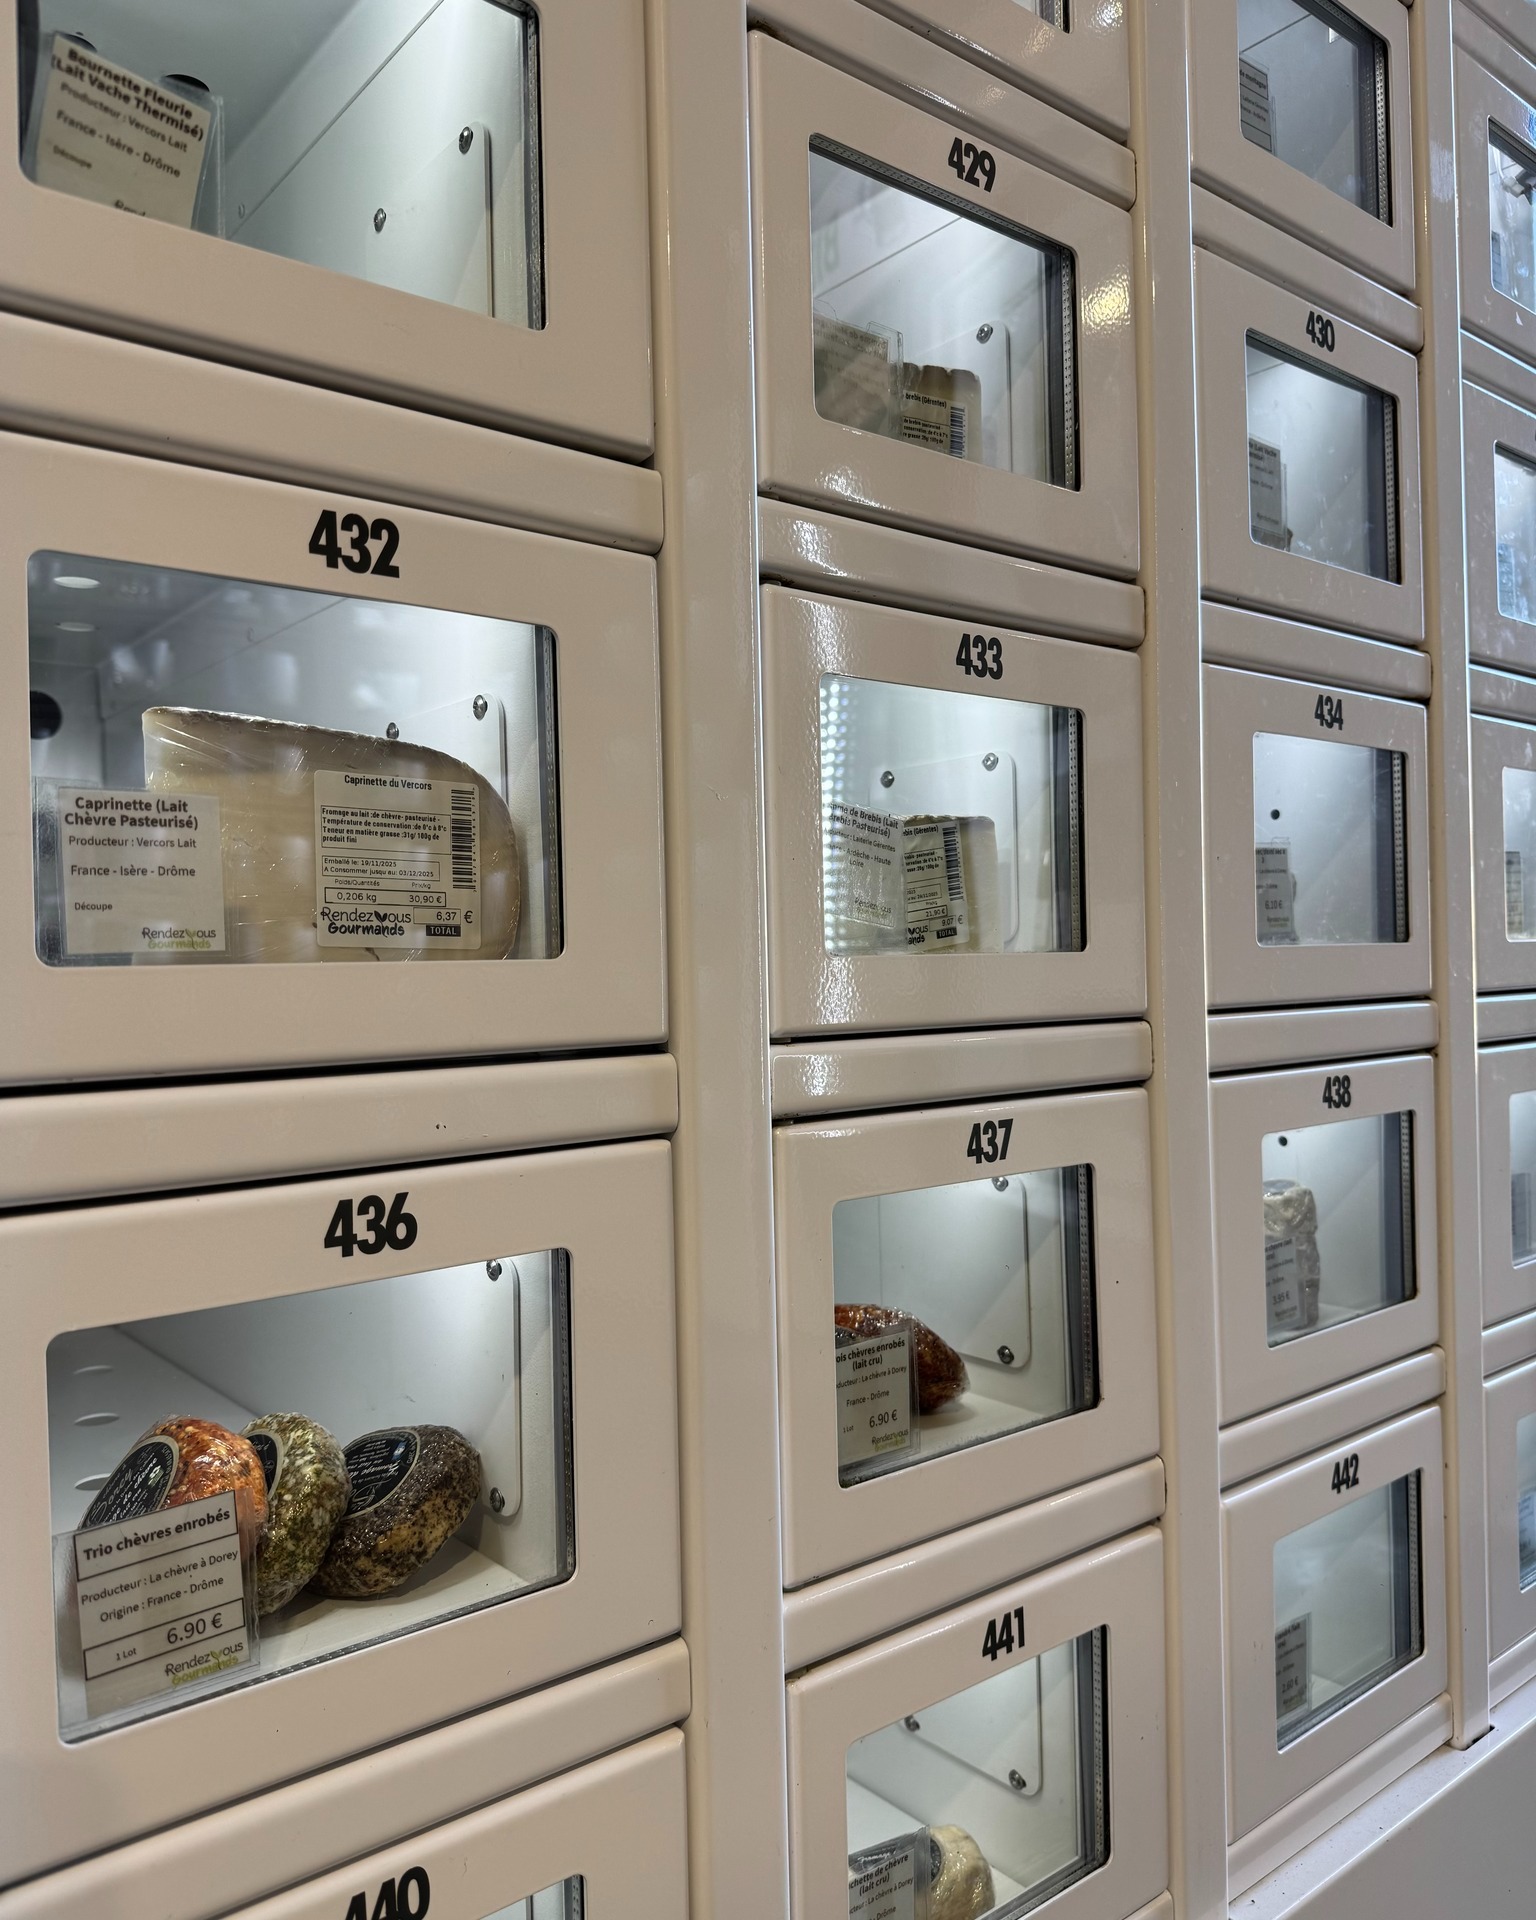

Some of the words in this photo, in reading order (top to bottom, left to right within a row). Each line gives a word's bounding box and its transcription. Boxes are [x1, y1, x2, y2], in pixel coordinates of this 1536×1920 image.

[68, 48, 141, 94] Bournette
[144, 87, 193, 119] Fleurie
[51, 54, 84, 82] (Lait
[88, 72, 130, 104] Vache
[134, 97, 204, 141] Thermisé)
[60, 82, 120, 119] Producteur
[129, 118, 166, 143] Vercors
[168, 136, 188, 153] Lait
[57, 109, 97, 138] France
[105, 134, 134, 156] Isère
[143, 151, 181, 178] Drôme
[948, 136, 996, 193] 429
[1306, 311, 1335, 353] 430
[309, 509, 400, 578] 432
[956, 634, 1003, 680] 433
[1314, 694, 1343, 731] 434
[344, 774, 387, 786] Caprinette
[389, 778, 399, 787] du
[401, 780, 432, 790] Vercors
[75, 796, 152, 812] Caprinette
[156, 799, 188, 814] (Lait
[322, 808, 349, 817] Fromage
[64, 812, 116, 826] Chèvre
[120, 814, 198, 831] Pasteurisé)
[322, 817, 363, 827] Température
[373, 821, 411, 830] conservation
[850, 808, 858, 817] de
[860, 810, 882, 824] Brebis
[883, 816, 898, 829] (Lait
[852, 819, 890, 839] Pasteurisé)
[323, 826, 345, 834] Teneur
[69, 835, 129, 847] Producteur
[136, 837, 175, 848] Vercors
[178, 838, 197, 848] Lait
[71, 865, 110, 876] France
[120, 864, 148, 876] Isère
[158, 865, 196, 877] Drôme
[74, 902, 113, 912] Découpe
[337, 892, 364, 901] 0,206
[366, 893, 376, 902] kg
[409, 895, 434, 904] 30,90
[436, 911, 457, 922] 6,37
[464, 910, 473, 924] €
[328, 922, 405, 936] Gourmands
[430, 926, 457, 935] TOTAL
[939, 929, 954, 937] TOTAL
[1323, 1075, 1351, 1110] 438
[967, 1118, 1014, 1164] 437
[324, 1192, 418, 1258] 436
[848, 1346, 876, 1360] chèvres
[877, 1338, 905, 1352] enrobés
[852, 1360, 867, 1372] (lait
[868, 1354, 883, 1365] cru)
[869, 1370, 886, 1380] chèvre
[847, 1397, 866, 1407] France
[870, 1390, 890, 1400] Drôme
[869, 1412, 889, 1428] 6.90
[892, 1409, 897, 1421] €
[1331, 1454, 1360, 1494] 442
[83, 1545, 113, 1560] Trio
[116, 1528, 172, 1551] chèvres
[174, 1508, 230, 1534] enrobés
[81, 1579, 142, 1605] Producteur
[149, 1572, 162, 1584] La
[164, 1563, 199, 1580] chèvre
[200, 1558, 207, 1568] à
[209, 1550, 238, 1566] Dorey
[100, 1602, 139, 1622] Origine
[147, 1590, 182, 1607] France
[190, 1576, 224, 1594] Drôme
[122, 1648, 137, 1659] Lot
[167, 1618, 206, 1644] 6.90
[211, 1612, 223, 1629] €
[982, 1606, 1025, 1662] 441
[875, 1868, 883, 1877] de
[885, 1854, 908, 1871] chèvre
[860, 1881, 874, 1896] (lait
[876, 1872, 890, 1886] cru)
[875, 1887, 893, 1900] chèvre
